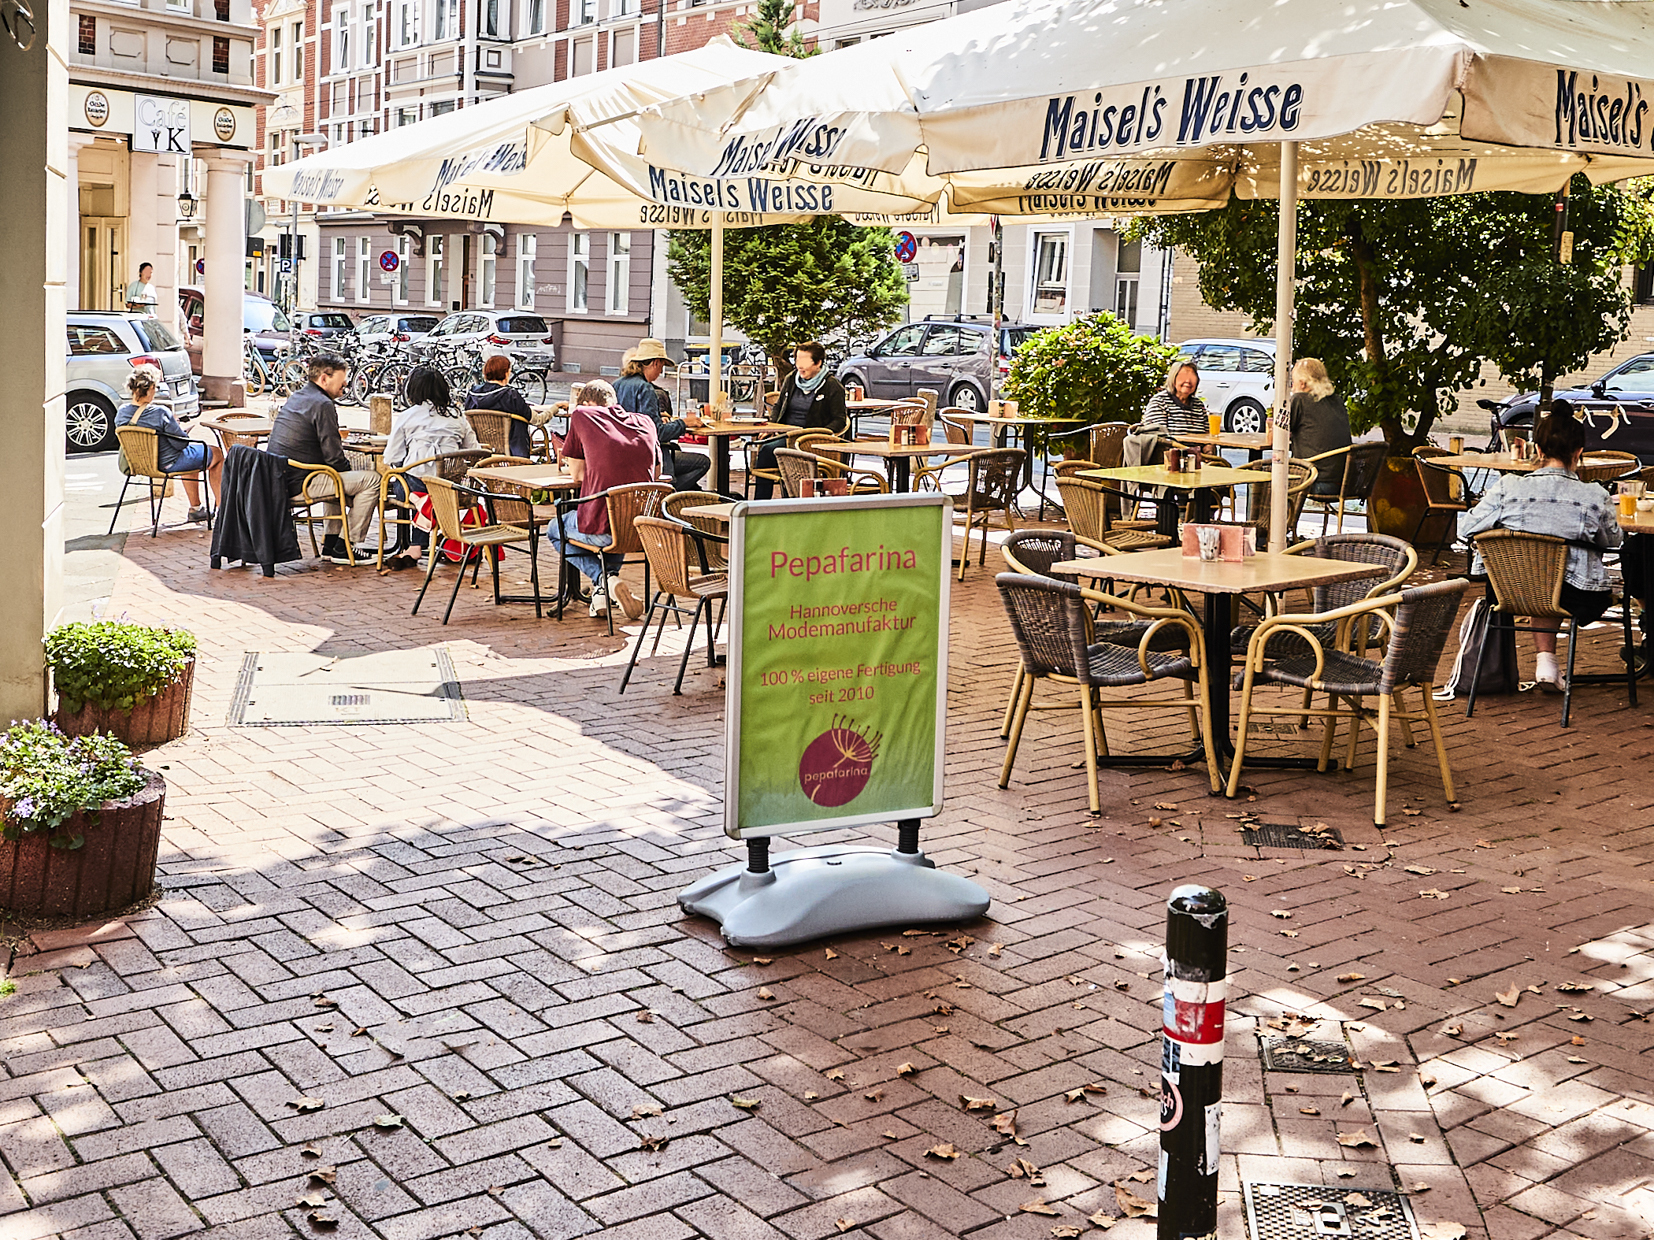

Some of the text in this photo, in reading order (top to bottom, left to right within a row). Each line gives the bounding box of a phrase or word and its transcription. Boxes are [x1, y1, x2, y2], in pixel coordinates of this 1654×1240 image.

[138, 98, 186, 128] Café
[1039, 72, 1303, 161] Maisel's Weisse
[1554, 70, 1648, 148] Maisel's
[166, 128, 186, 152] K
[747, 178, 834, 213] Weisse
[771, 544, 917, 582] Pepafarina
[790, 598, 898, 619] Hannoversche
[768, 615, 917, 641] Modemanufaktur
[760, 661, 921, 687] 100 % eigene Fertigung
[809, 686, 875, 706] seit 2010
[804, 766, 868, 785] pepafarina
